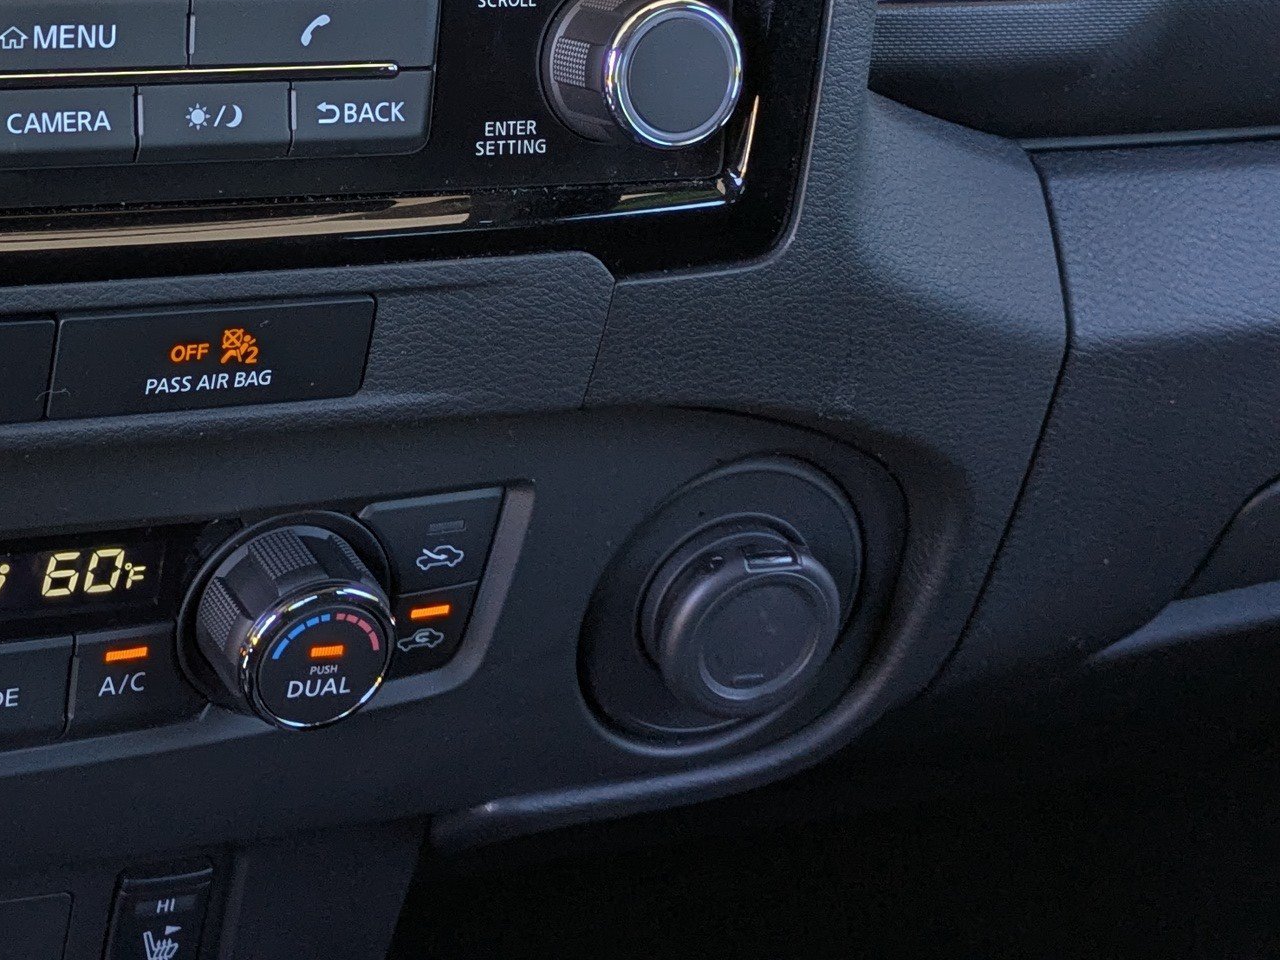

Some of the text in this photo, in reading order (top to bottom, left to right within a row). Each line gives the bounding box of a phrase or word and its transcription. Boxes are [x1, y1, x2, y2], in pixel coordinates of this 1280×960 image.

[33, 24, 117, 50] MENU
[6, 110, 112, 135] CAMERA
[343, 100, 406, 124] BACK
[484, 120, 537, 137] ENTER
[475, 139, 547, 156] SETTING
[170, 342, 210, 363] OFF
[144, 369, 272, 395] PASS AIR BAG
[310, 665, 339, 676] PUSH
[98, 672, 146, 697] A/C
[287, 677, 351, 699] DUAL
[157, 898, 176, 914] HI
